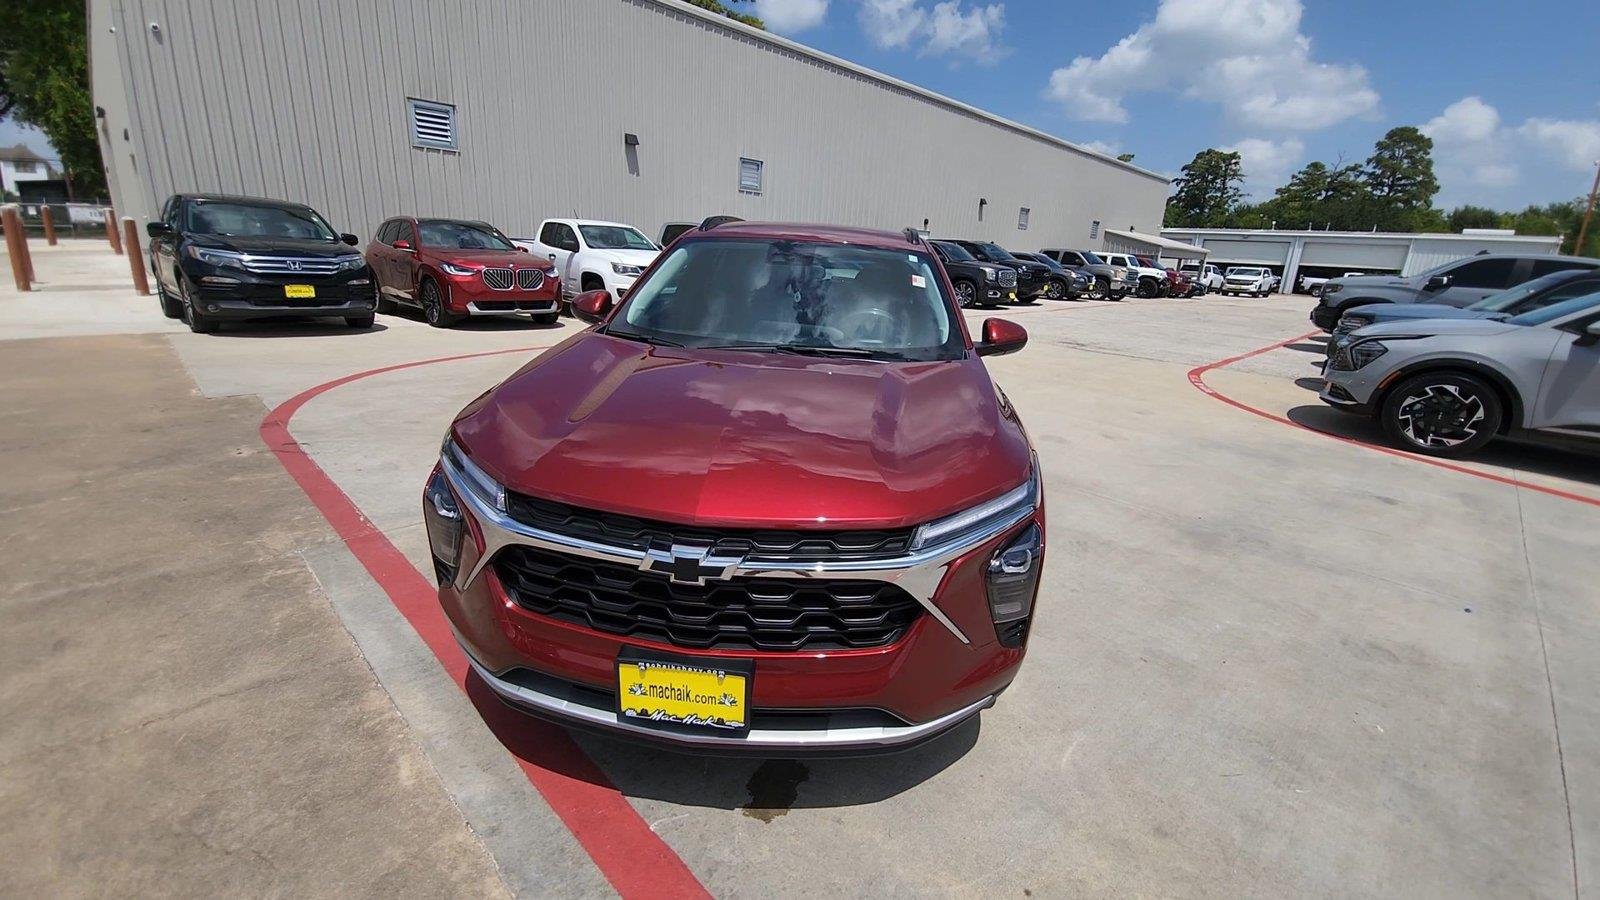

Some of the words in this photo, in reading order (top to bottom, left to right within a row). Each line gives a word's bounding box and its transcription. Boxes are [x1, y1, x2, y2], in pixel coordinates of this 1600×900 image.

[648, 682, 717, 705] machaik.com
[651, 709, 681, 722] Mac
[682, 714, 721, 728] Haik
